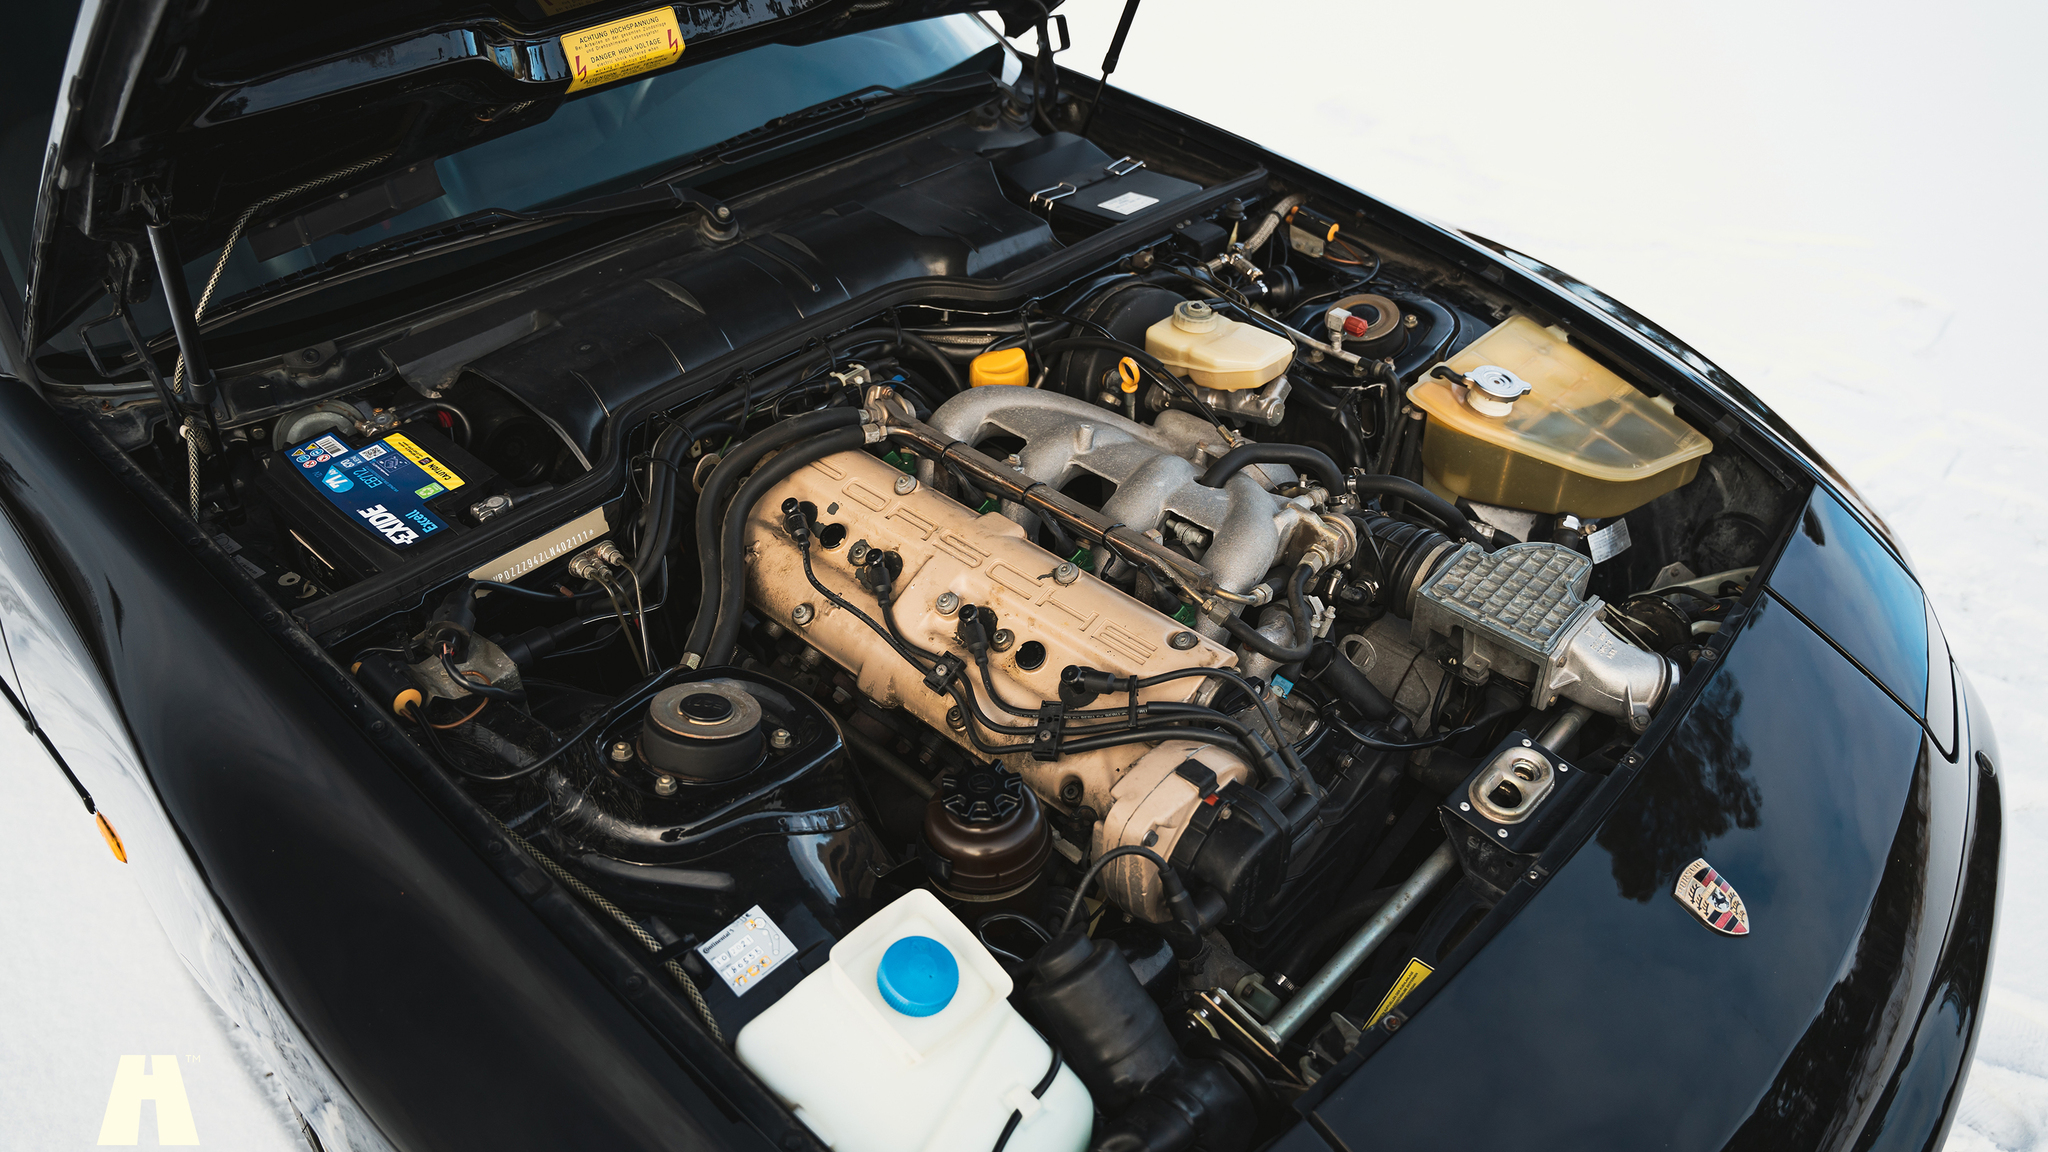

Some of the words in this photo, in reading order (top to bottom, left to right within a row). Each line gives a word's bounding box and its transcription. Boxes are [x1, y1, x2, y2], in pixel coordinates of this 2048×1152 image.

[578, 30, 608, 43] ACHTUNG
[609, 15, 659, 34] HOCHSPANNUNG
[584, 39, 602, 47] Arbeiten
[590, 50, 616, 63] DANGER
[617, 45, 633, 54] HIGH
[634, 37, 661, 49] VOLTAGE
[596, 58, 613, 67] electric
[628, 49, 646, 57] suffered
[595, 65, 612, 73] working
[324, 476, 349, 489] 71
[353, 468, 382, 488] EB712
[427, 464, 452, 481] CAUTION
[358, 504, 419, 545] EXIDE
[405, 509, 438, 533] Excell
[1678, 861, 1704, 895] PORSCHE
[702, 931, 730, 954] Continental
